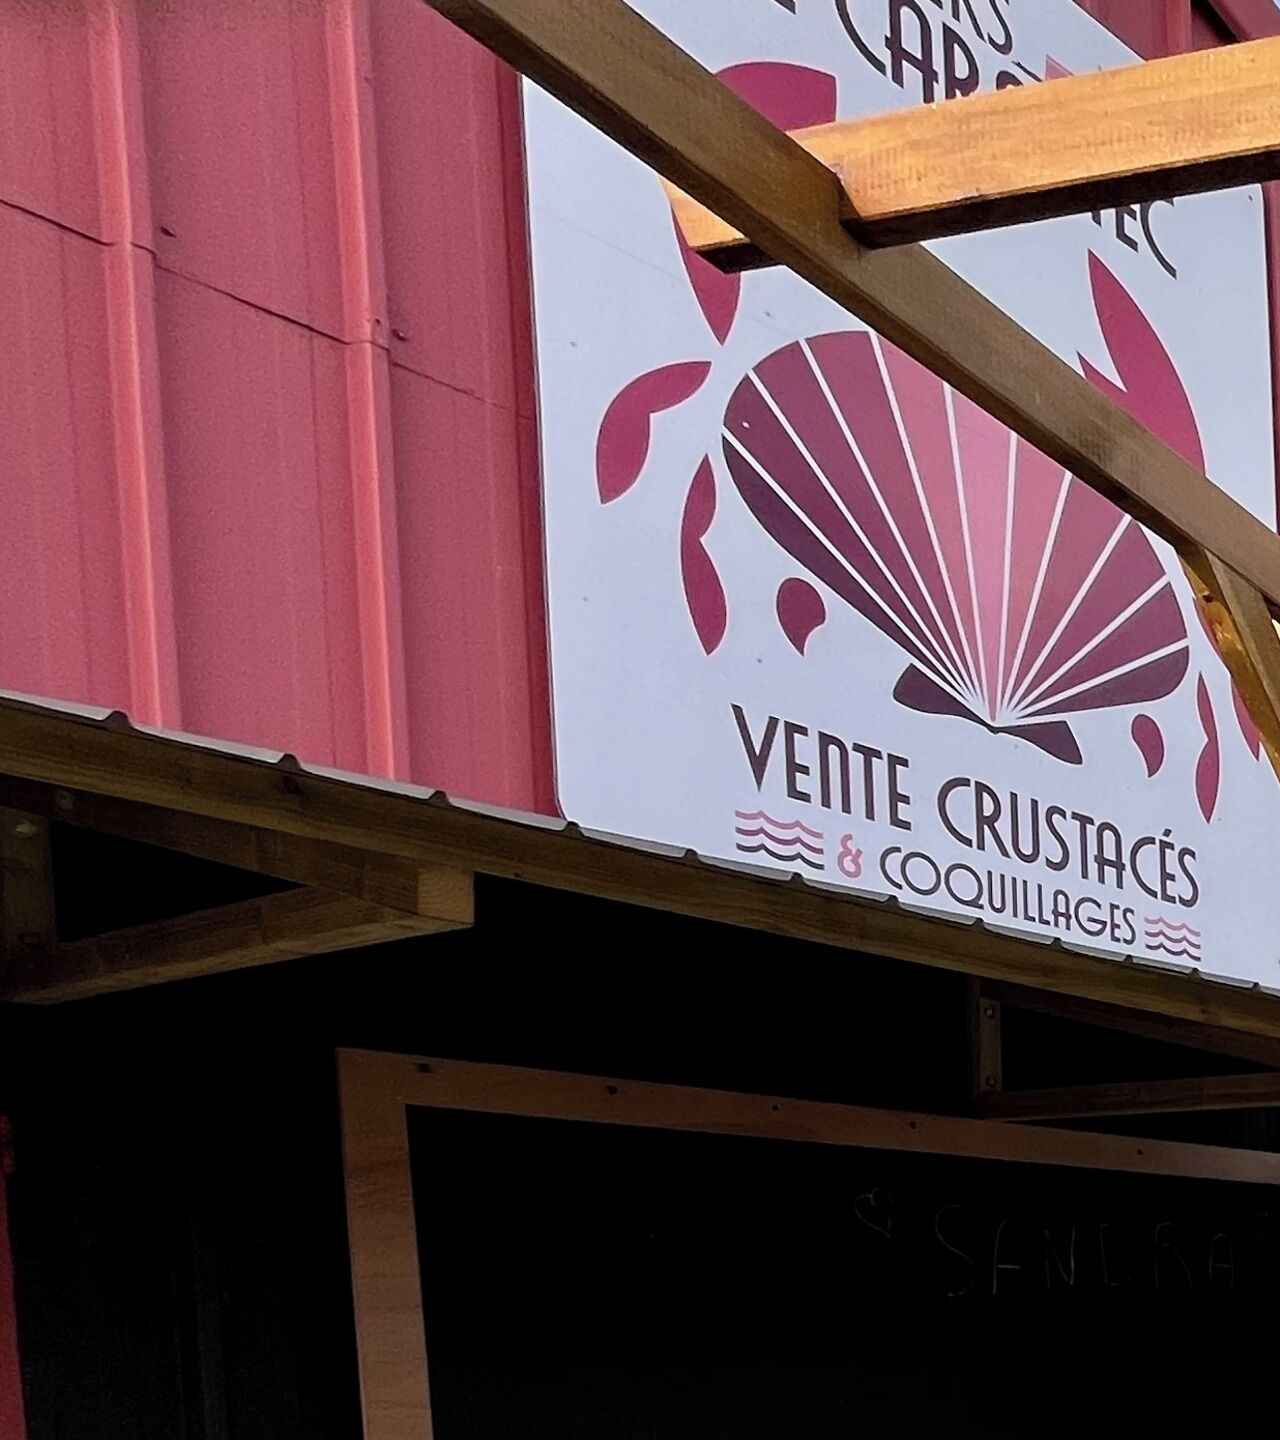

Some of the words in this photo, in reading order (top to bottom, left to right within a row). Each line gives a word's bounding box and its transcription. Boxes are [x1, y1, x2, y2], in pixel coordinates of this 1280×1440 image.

[731, 703, 912, 831] VENTE
[937, 776, 1200, 908] CRUSTACÉS
[838, 833, 862, 878] &
[879, 846, 1136, 945] COQUILLAGES
